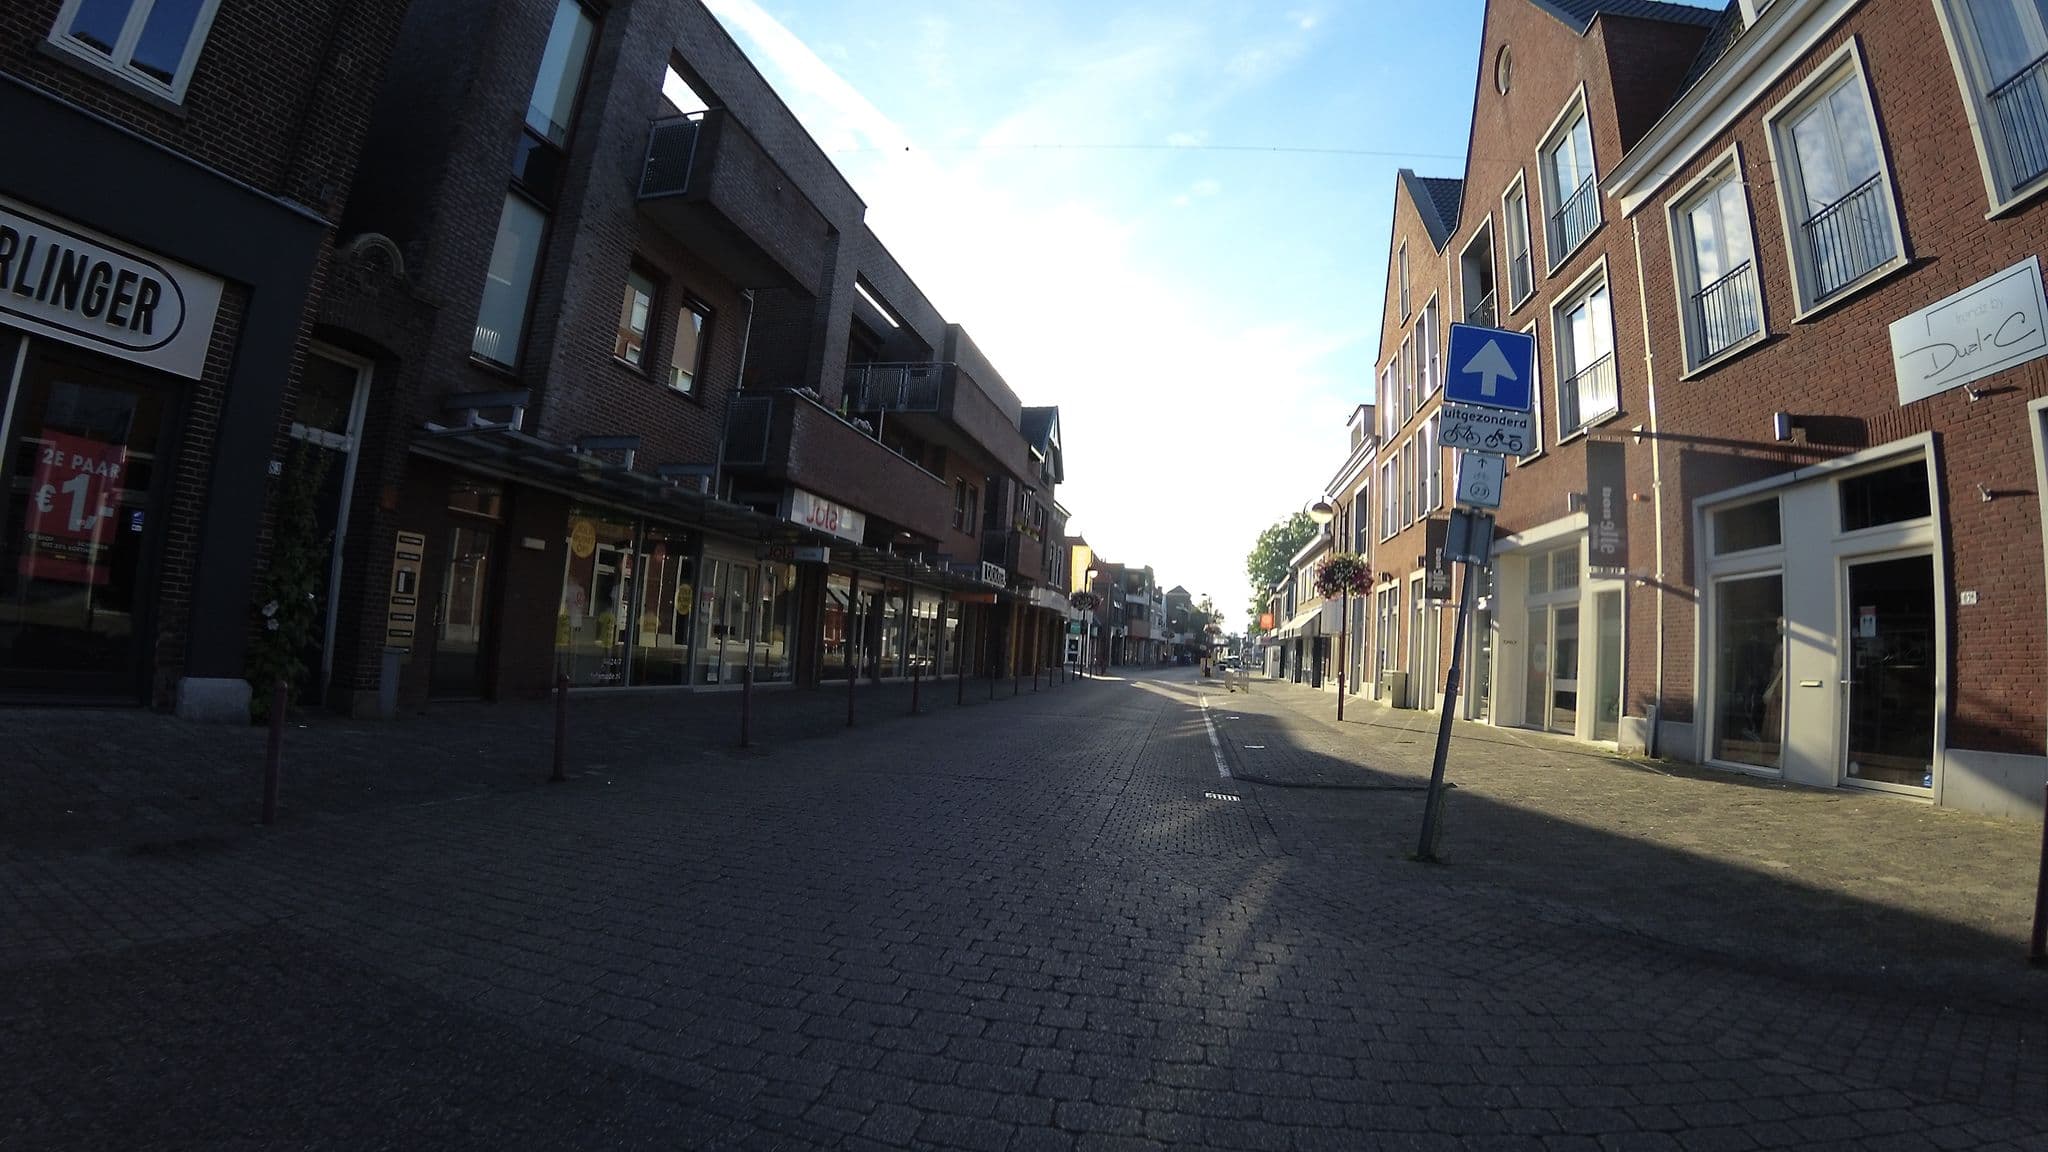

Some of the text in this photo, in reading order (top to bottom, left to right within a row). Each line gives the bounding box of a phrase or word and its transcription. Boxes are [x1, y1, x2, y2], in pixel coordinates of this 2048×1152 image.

[0, 224, 162, 335] RLINGER
[1899, 311, 2037, 380] Dual-C
[1444, 409, 1527, 428] uitgezonderd
[42, 448, 121, 478] 2E PAAR
